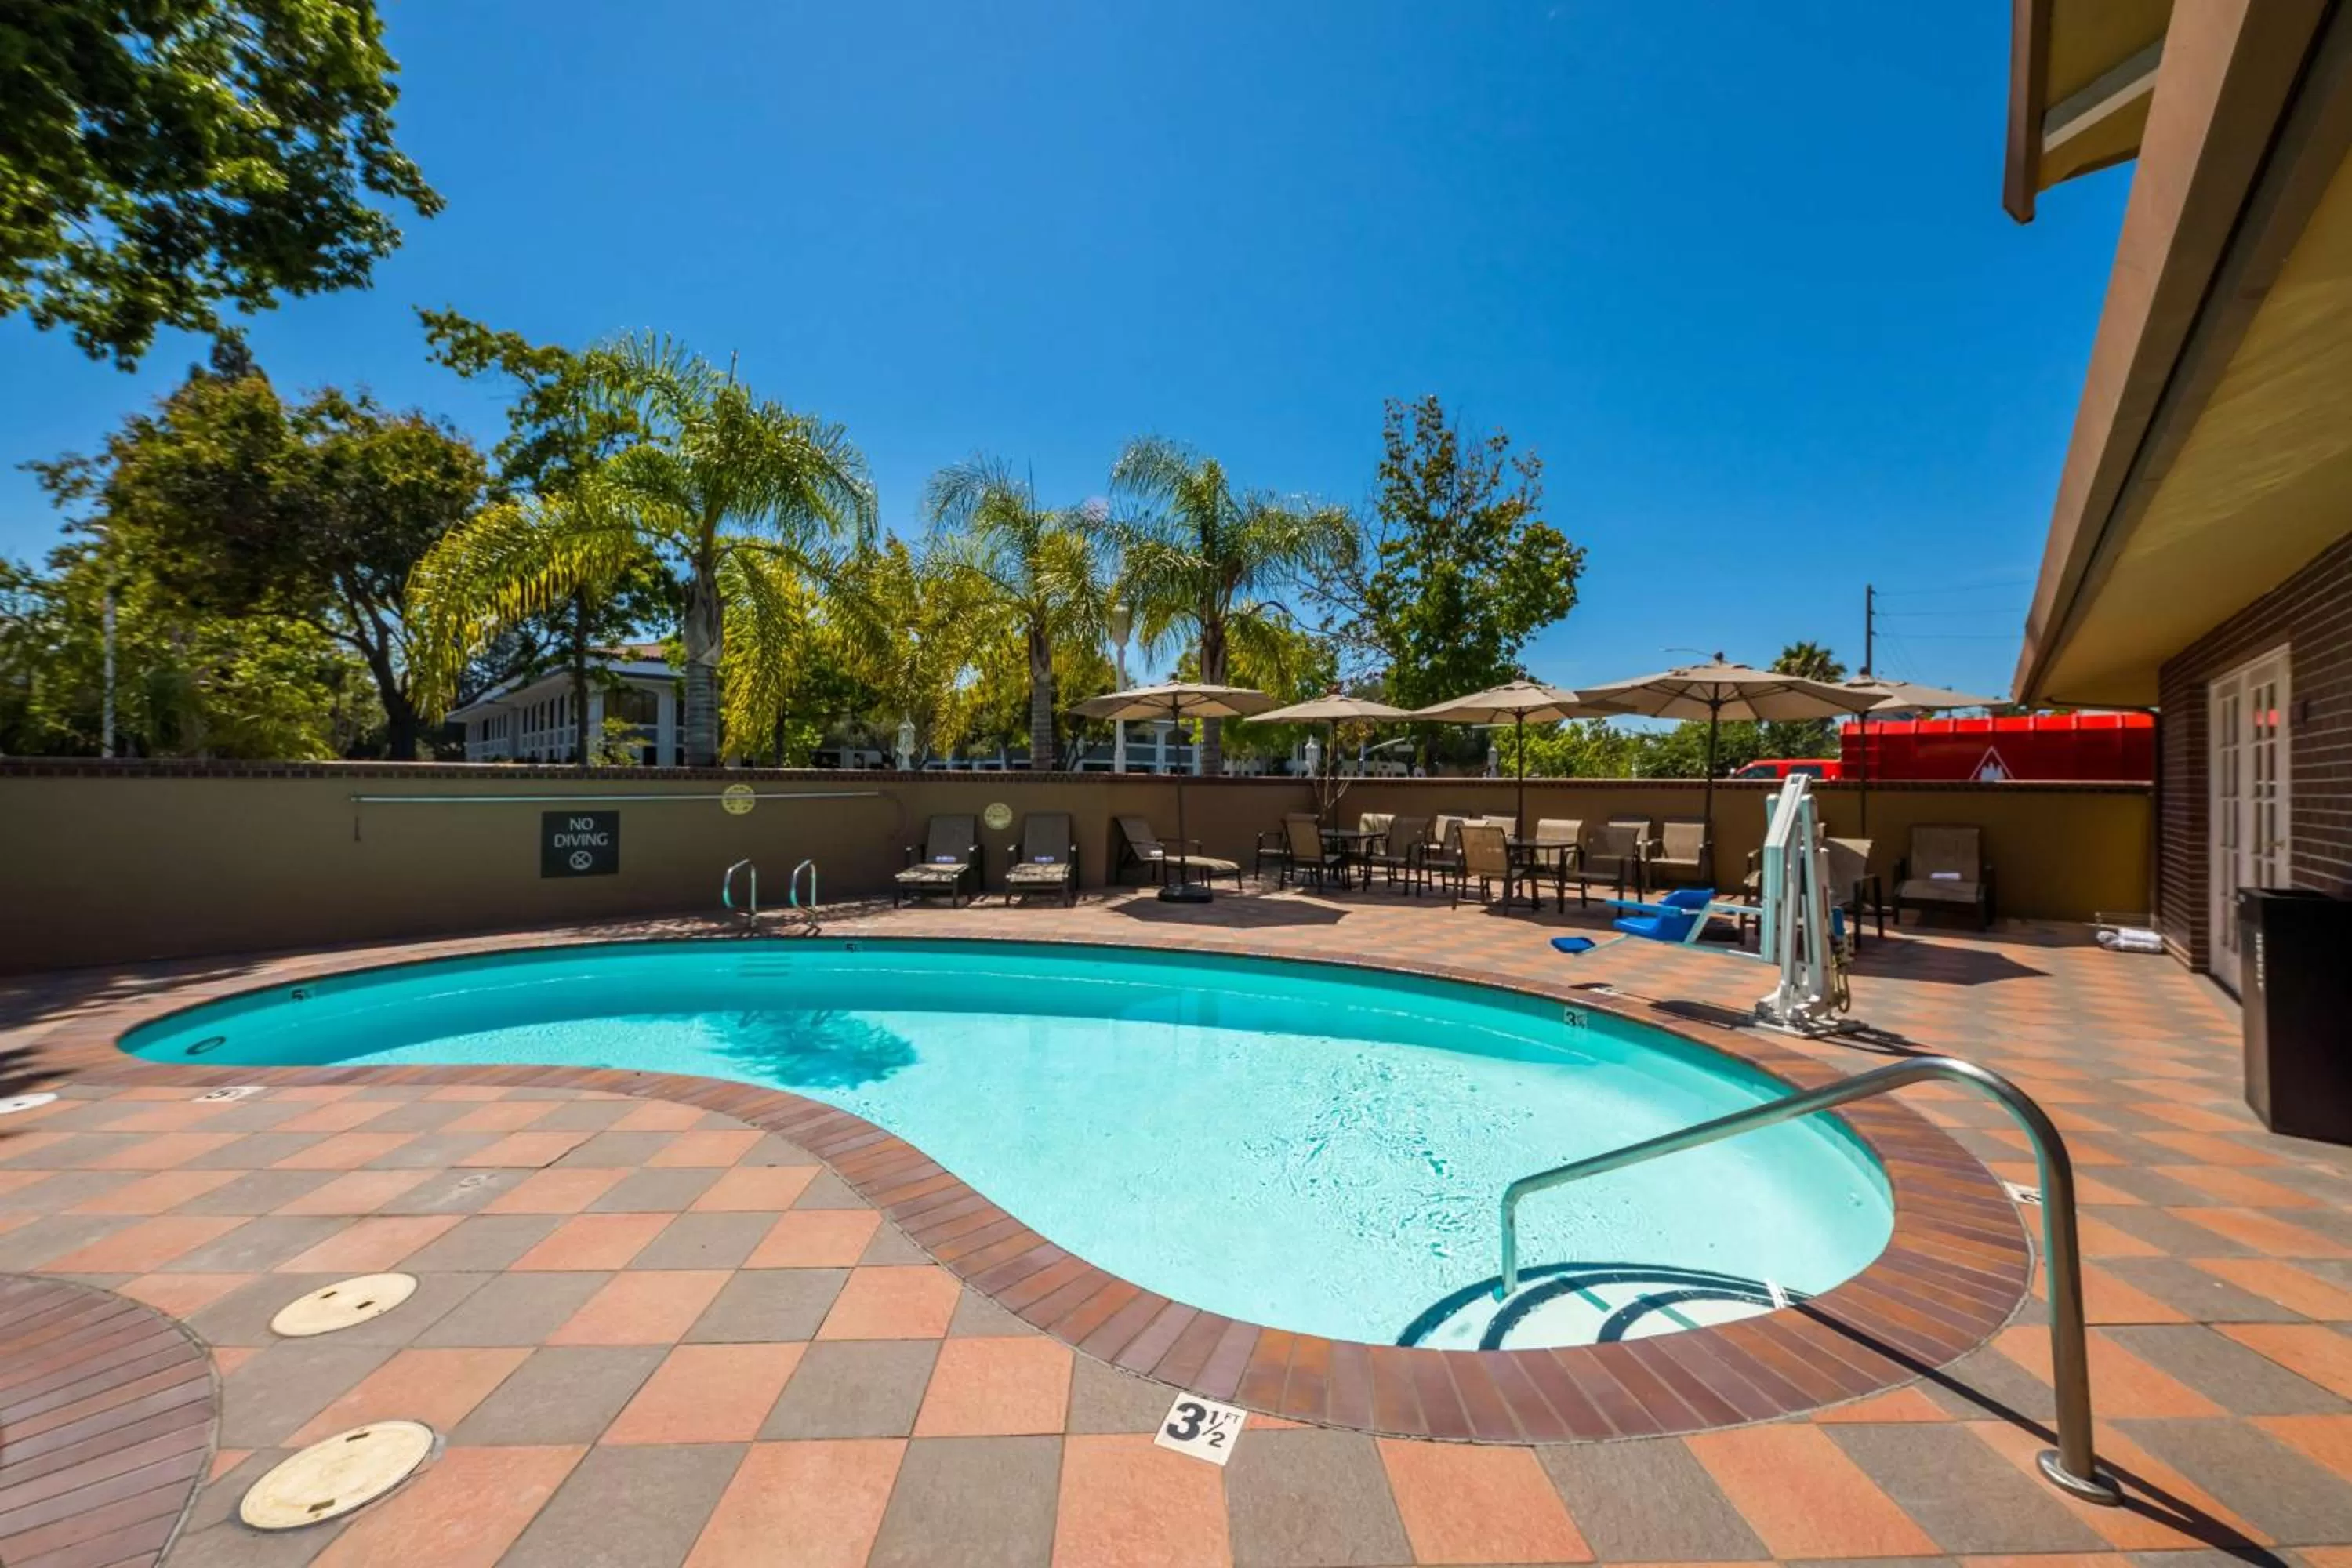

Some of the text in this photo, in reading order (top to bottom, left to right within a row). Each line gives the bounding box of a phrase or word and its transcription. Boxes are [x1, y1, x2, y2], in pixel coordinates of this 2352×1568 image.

[569, 817, 594, 831] NO
[554, 832, 609, 848] DIVING
[1224, 1412, 1241, 1425] FT
